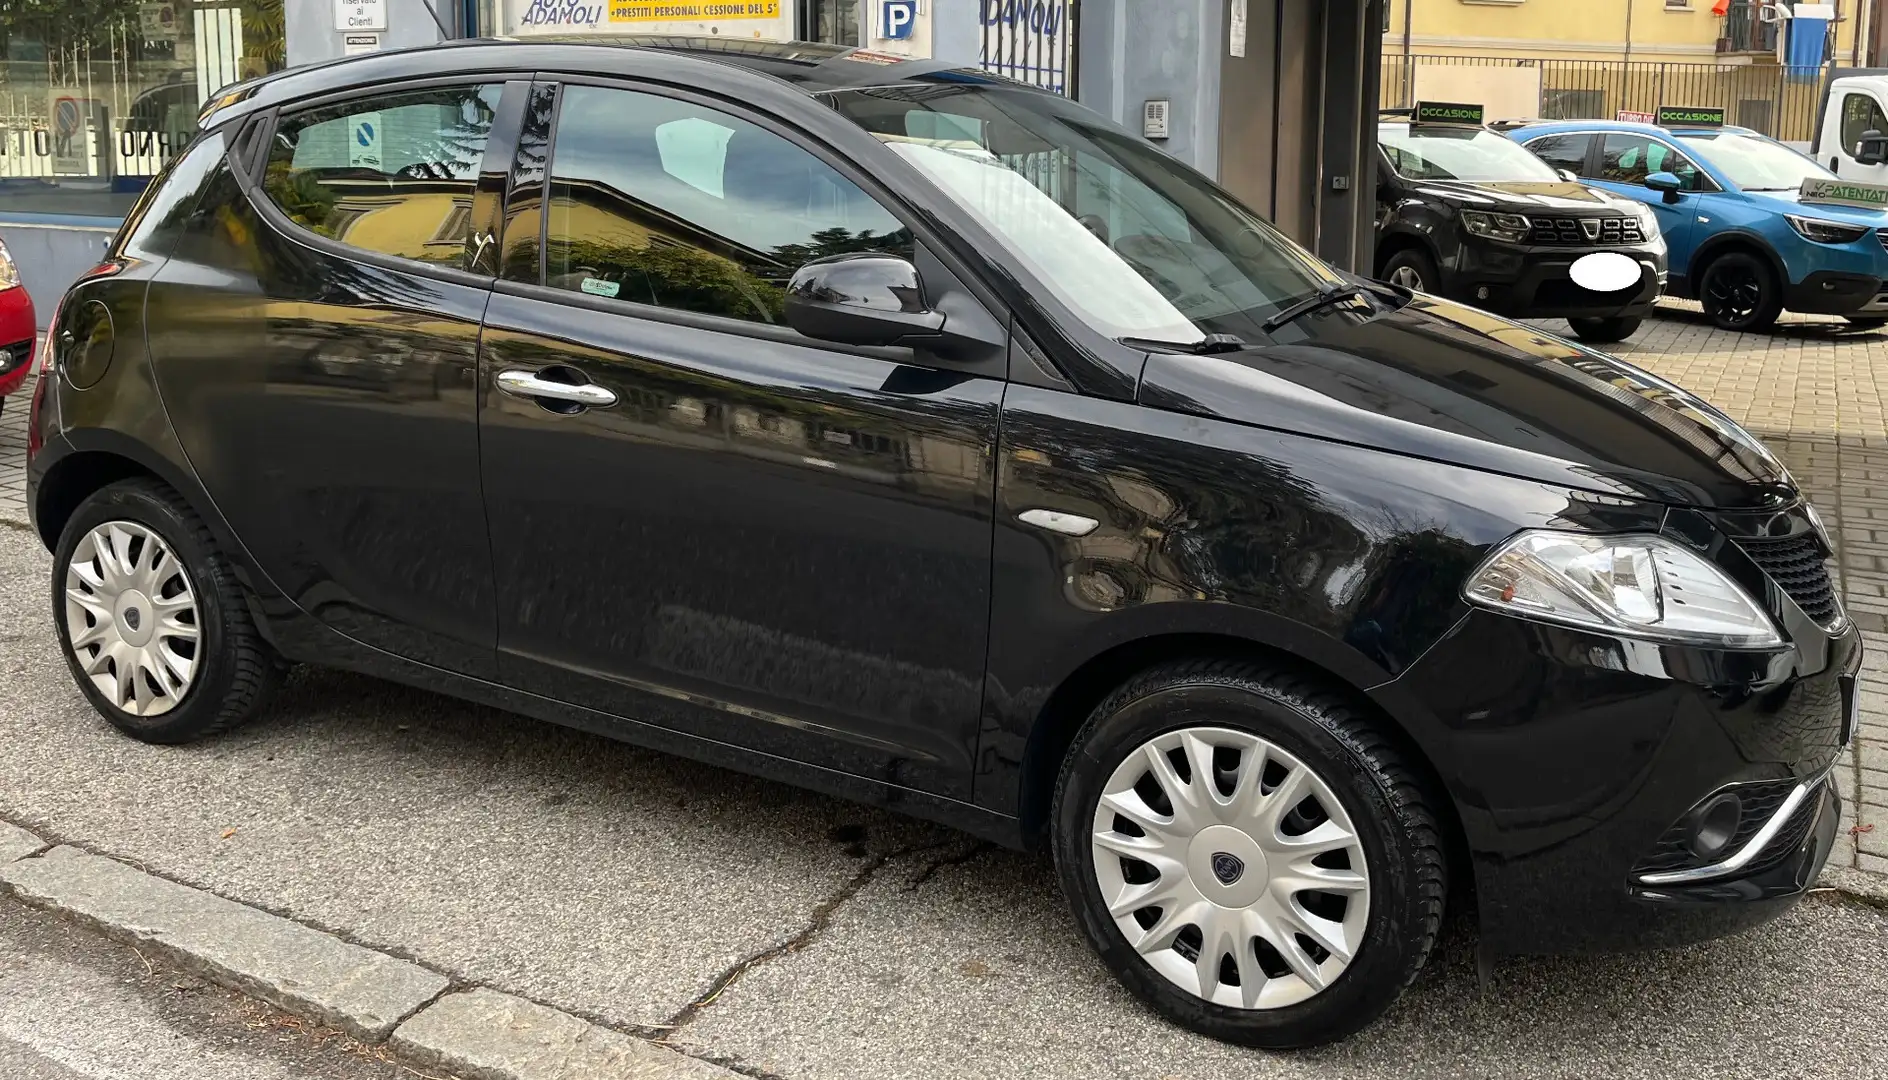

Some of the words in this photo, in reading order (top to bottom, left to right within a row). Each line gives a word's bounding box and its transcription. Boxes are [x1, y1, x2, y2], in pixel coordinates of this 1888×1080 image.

[521, 5, 603, 26] ADAMOLI
[616, 7, 652, 18] PRESTITI
[654, 5, 701, 17] PERSONALI
[703, 4, 745, 16] CESSIONE
[748, 3, 764, 14] DEL
[889, 4, 911, 36] P
[1420, 107, 1482, 120] OCCASIONE
[1660, 111, 1723, 123] OCCASIONE
[1805, 190, 1826, 199] NEO
